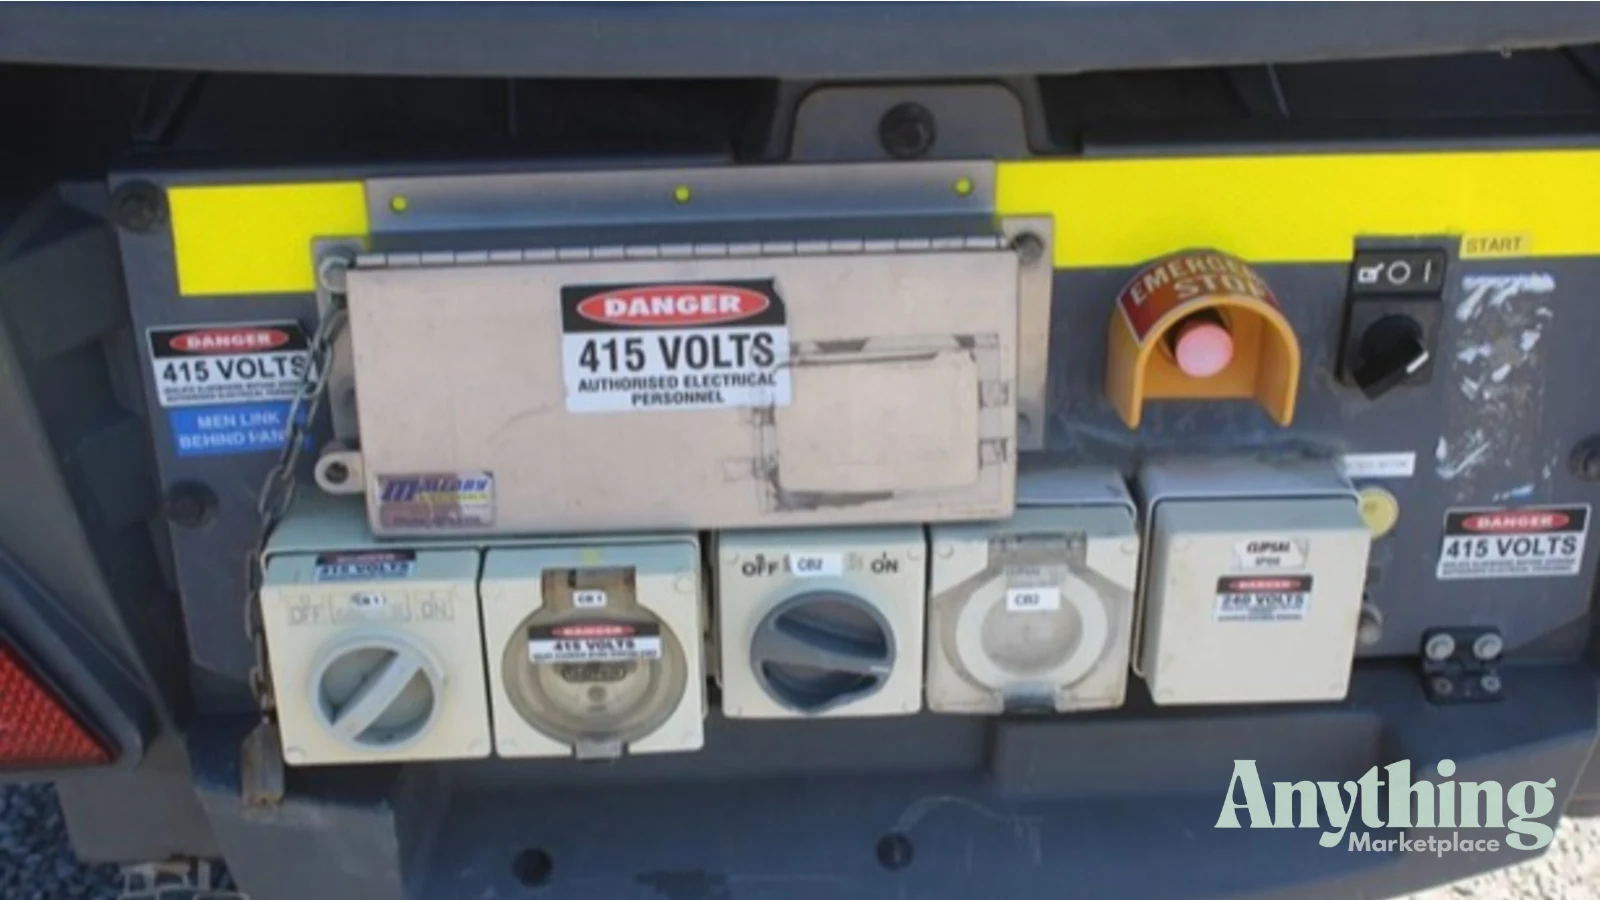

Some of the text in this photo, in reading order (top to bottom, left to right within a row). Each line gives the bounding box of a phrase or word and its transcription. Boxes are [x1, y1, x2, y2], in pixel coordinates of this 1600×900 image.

[1465, 234, 1523, 253] START
[1174, 274, 1266, 298] STOP
[603, 293, 741, 318] DANGER
[187, 332, 270, 348] DANGER
[578, 332, 775, 373] 415 VOLTS
[163, 356, 307, 382] 415 VOLTS
[577, 370, 777, 393] AUTHORISED ELECTRICAL
[631, 391, 726, 406] PERSONNEL
[197, 415, 236, 429] MEN
[178, 434, 246, 449] BEHIND
[1477, 515, 1553, 529] DANGER
[1447, 535, 1578, 558] 415 VOLTS
[741, 561, 778, 577] OFF
[870, 560, 899, 574] ON
